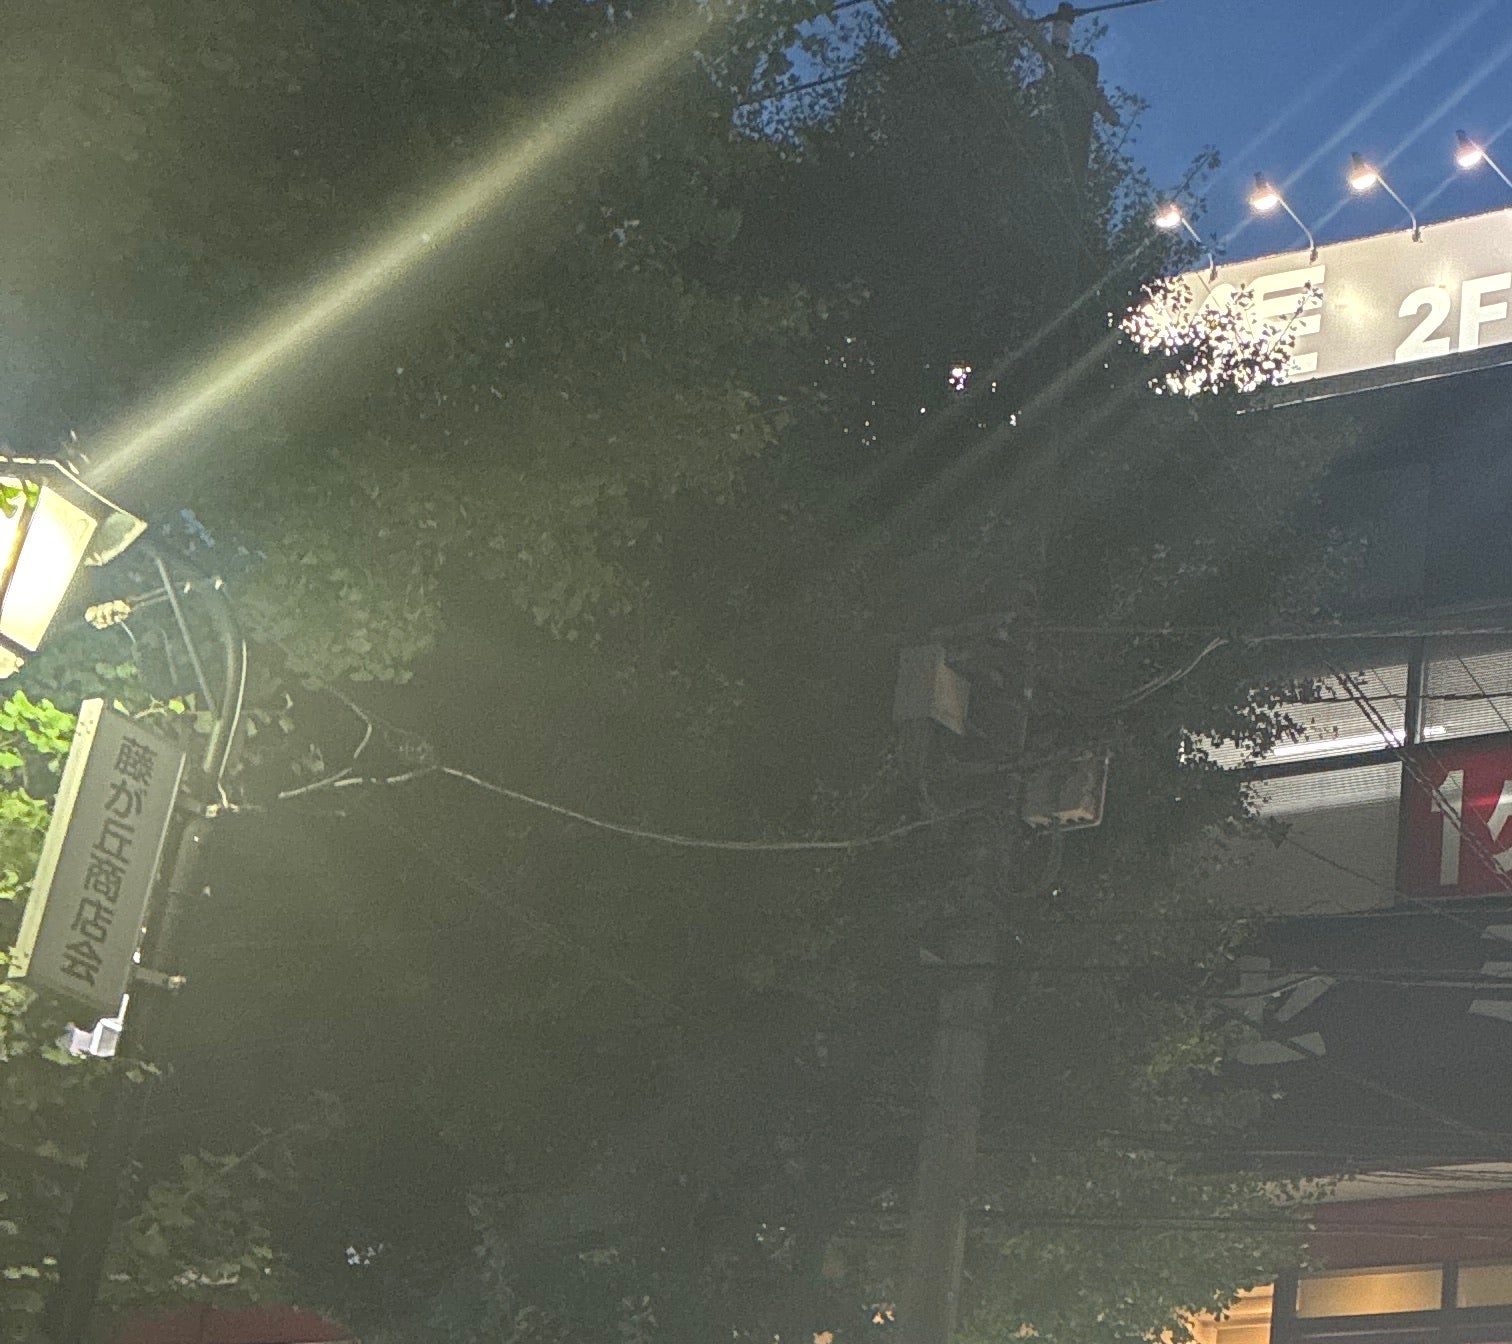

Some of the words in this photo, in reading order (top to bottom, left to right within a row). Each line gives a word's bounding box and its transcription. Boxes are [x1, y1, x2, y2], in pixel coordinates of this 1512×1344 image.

[1395, 272, 1512, 363] 2F
[60, 735, 158, 989] 藤が丘商店会
